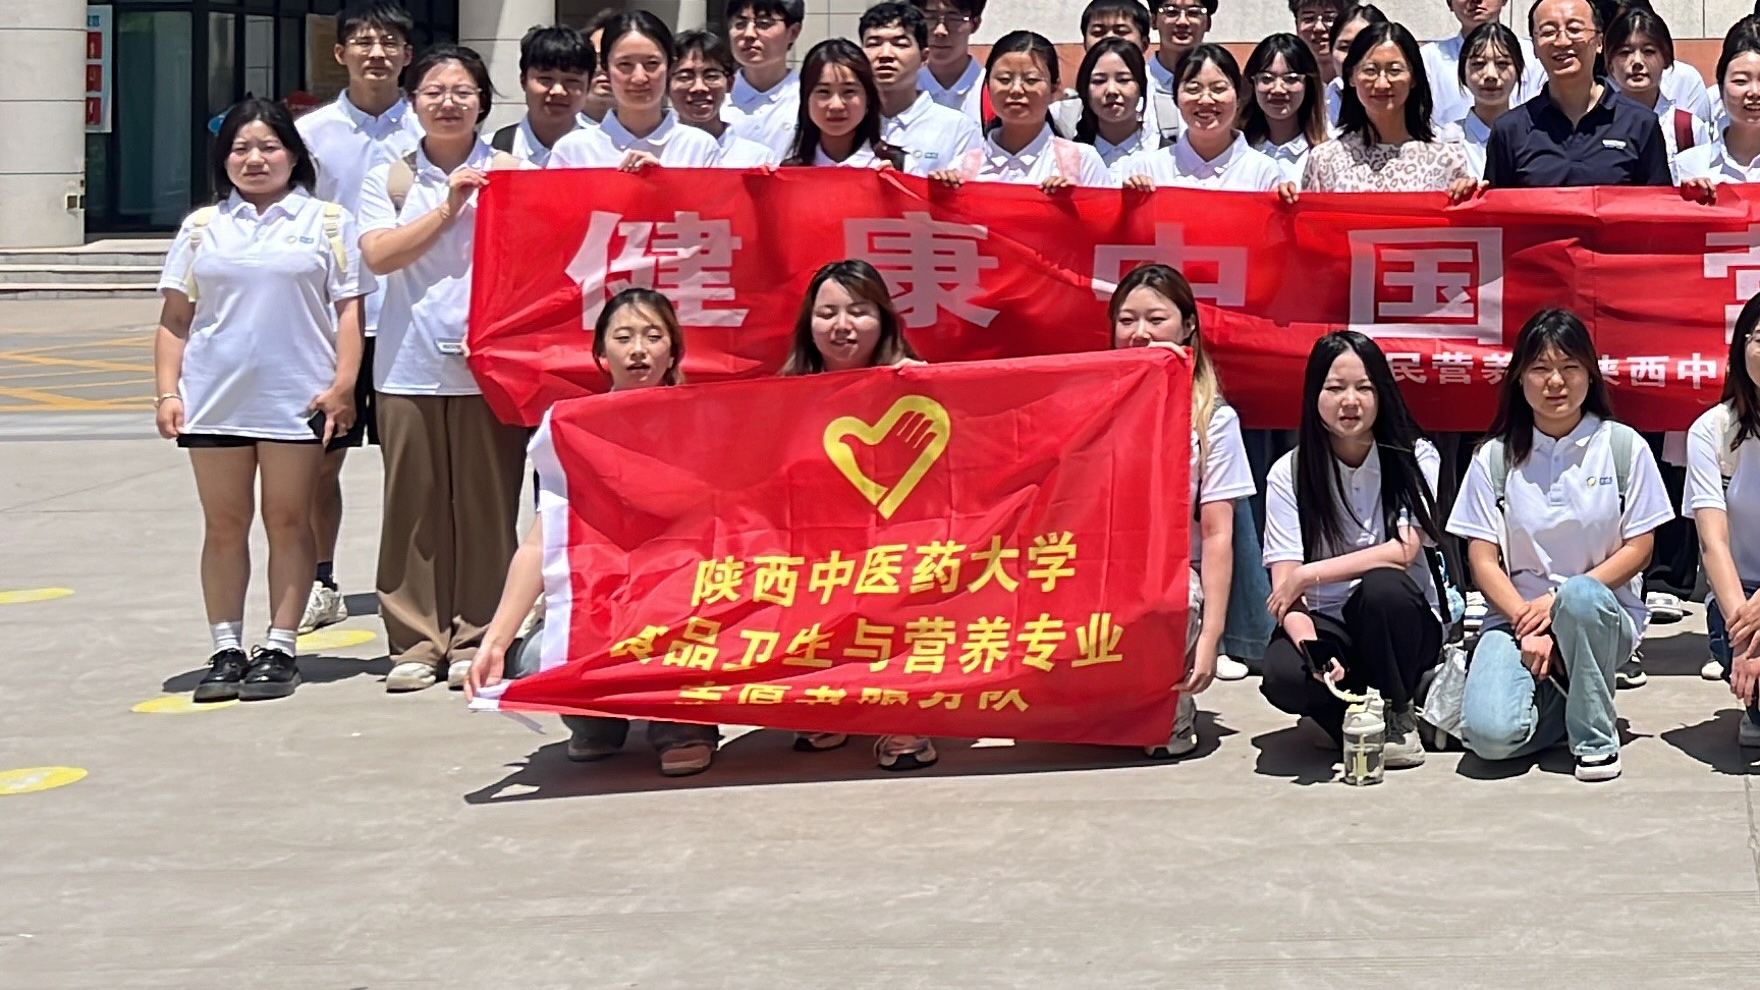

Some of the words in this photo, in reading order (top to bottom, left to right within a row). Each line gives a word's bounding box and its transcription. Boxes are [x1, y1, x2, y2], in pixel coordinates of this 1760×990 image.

[691, 530, 1077, 607] 陕西中医药大学
